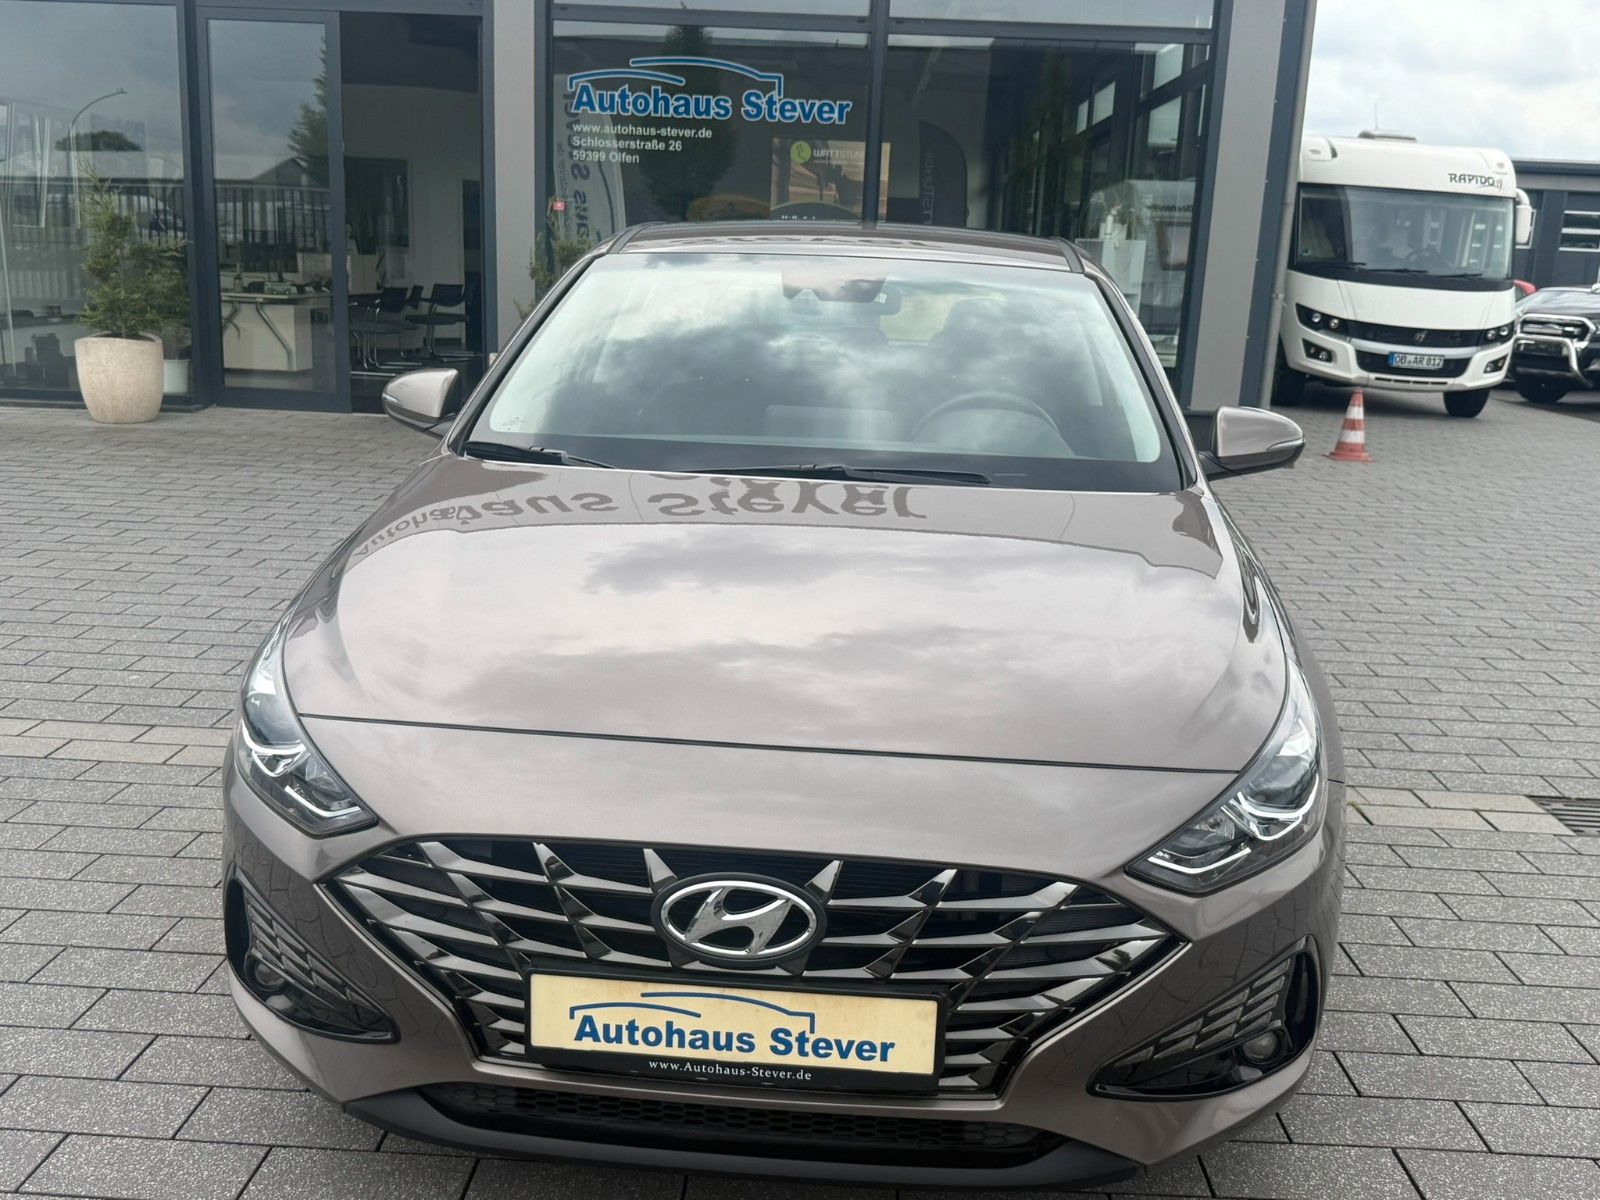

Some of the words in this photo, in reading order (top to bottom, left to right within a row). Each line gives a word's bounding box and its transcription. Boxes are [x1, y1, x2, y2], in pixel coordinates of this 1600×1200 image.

[572, 83, 732, 120] Autohaus
[741, 90, 853, 125] Stever
[572, 123, 713, 140] www.autohaus-stever.de
[572, 135, 666, 152] Schlosserstraße
[668, 140, 683, 152] 26
[572, 150, 606, 164] 59399
[609, 152, 640, 165] Olfen
[1448, 173, 1495, 187] RAPIDO
[573, 1014, 757, 1054] Autohaus
[768, 1028, 896, 1063] Stever
[648, 1059, 813, 1082] www.Autohaus-Stever.de
